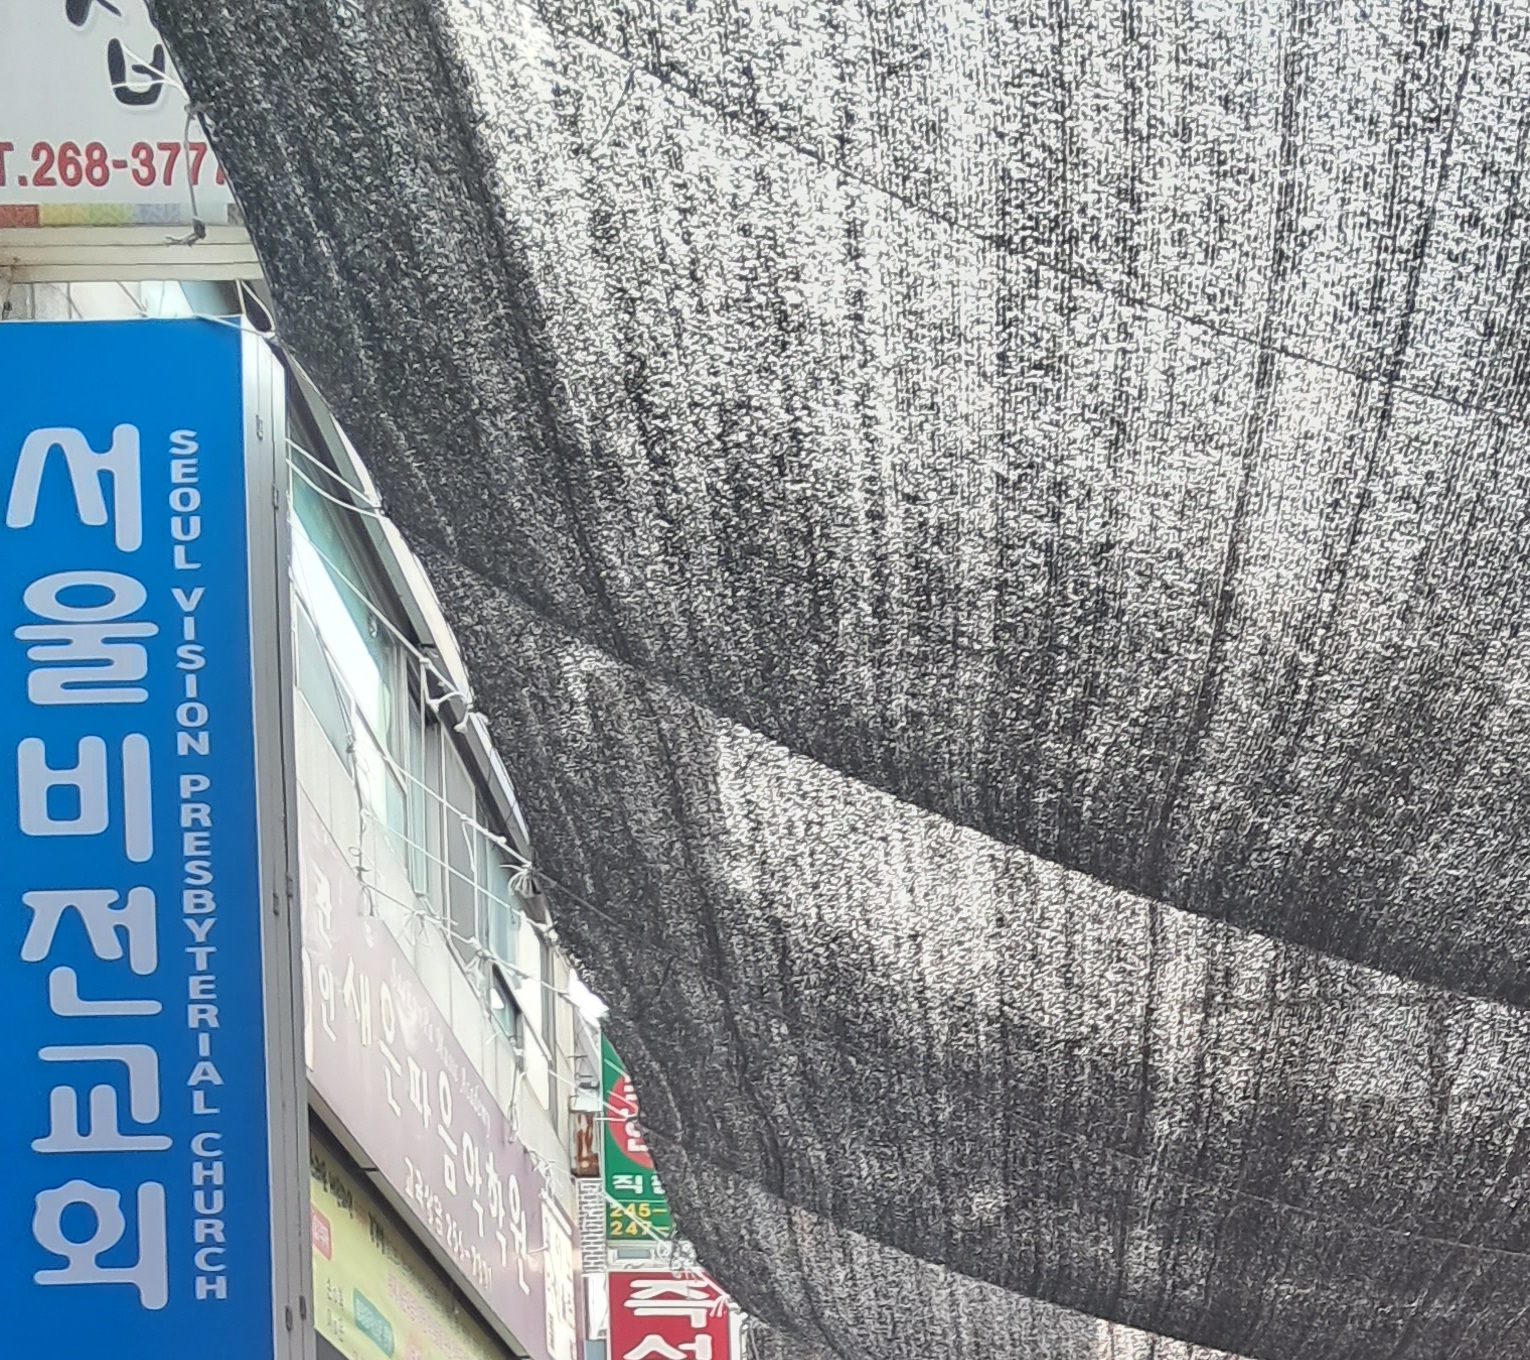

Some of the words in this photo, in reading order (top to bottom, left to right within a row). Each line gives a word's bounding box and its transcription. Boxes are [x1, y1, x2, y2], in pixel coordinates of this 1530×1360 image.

[169, 430, 203, 571] SEOUL
[172, 586, 211, 758] VISION
[6, 424, 173, 1310] 서울비전교회
[180, 775, 224, 1116] PRESBYTERIAL
[190, 1134, 228, 1300] CHURCH
